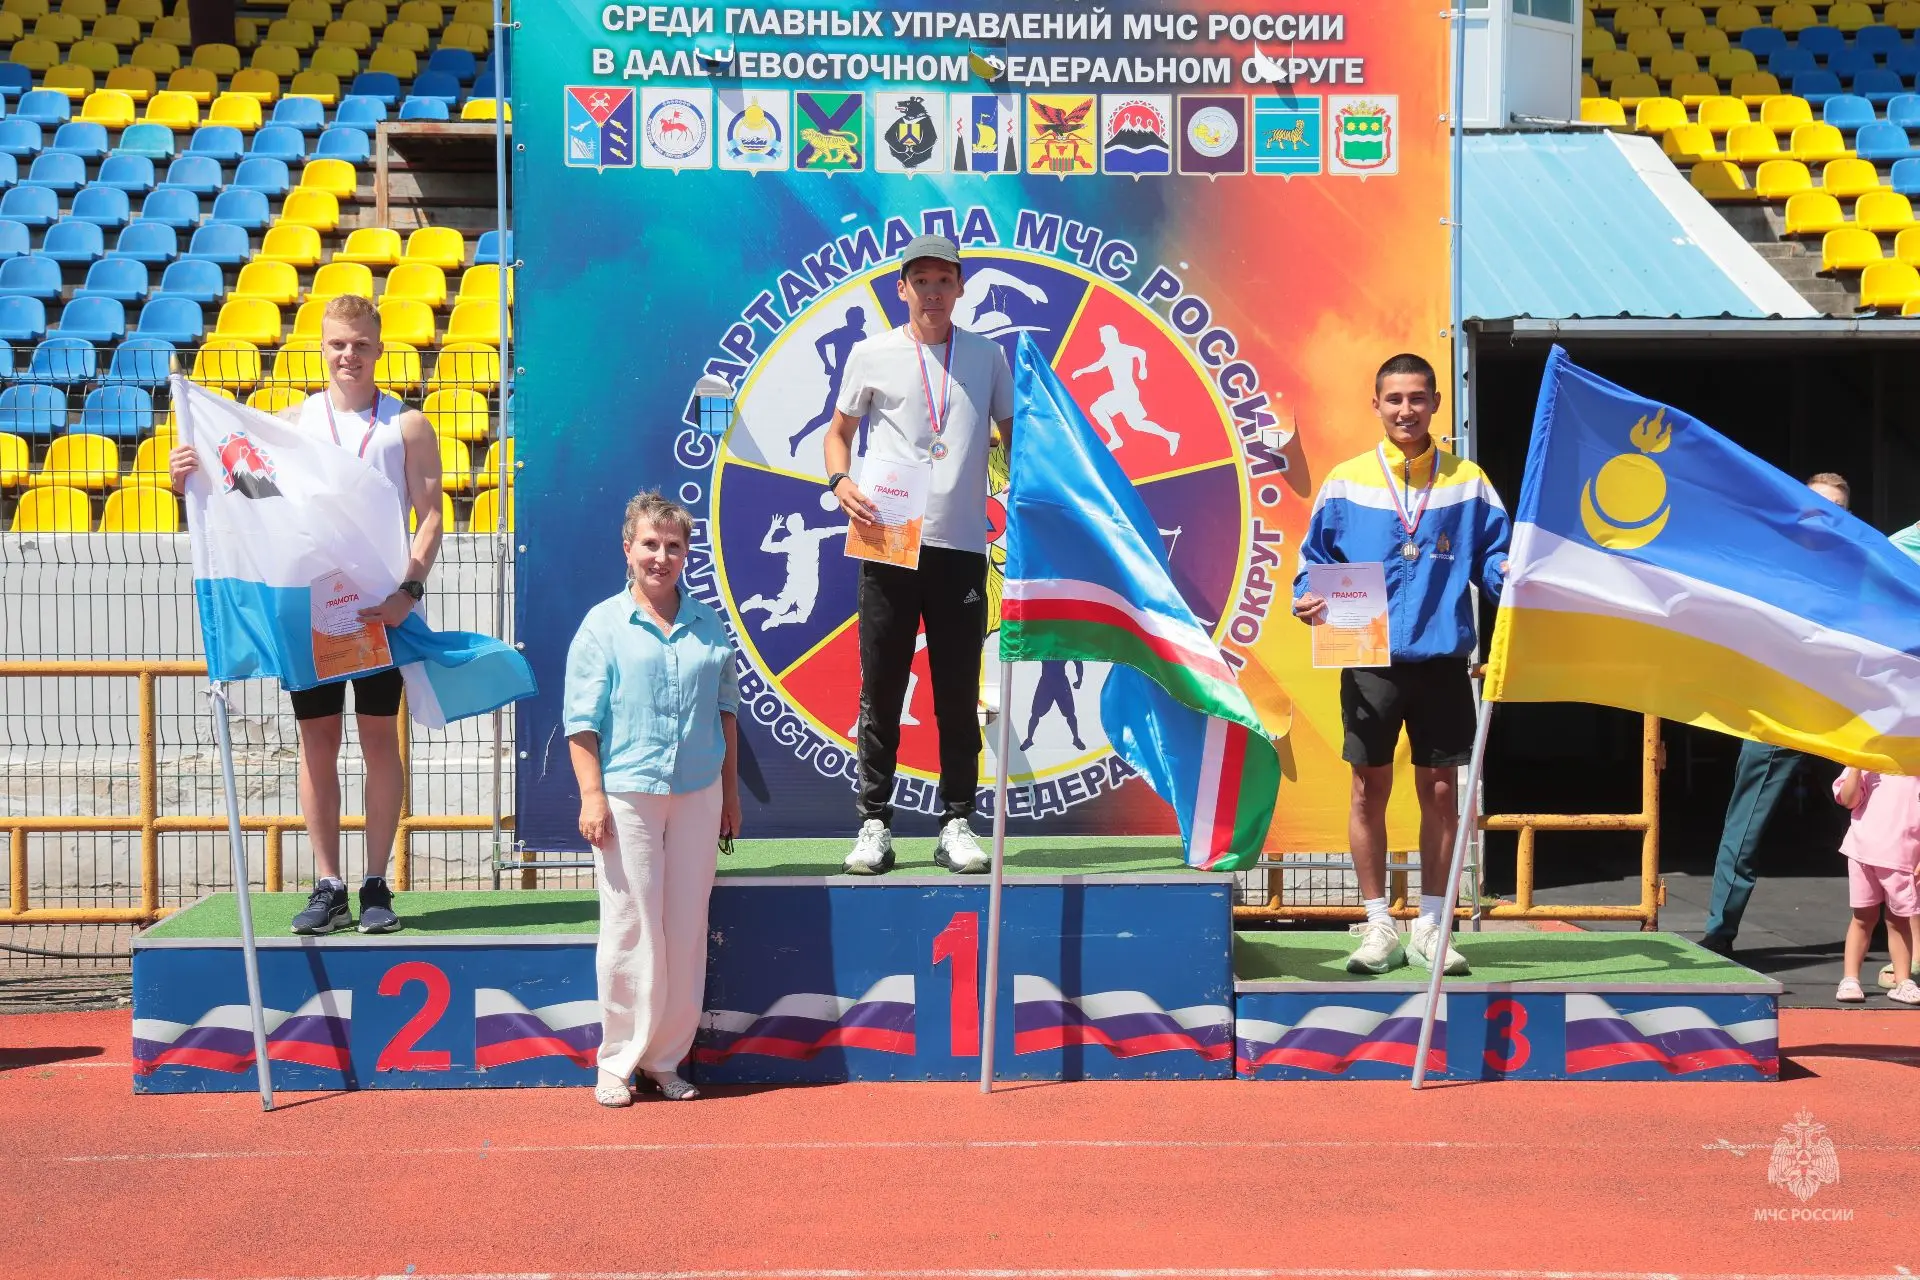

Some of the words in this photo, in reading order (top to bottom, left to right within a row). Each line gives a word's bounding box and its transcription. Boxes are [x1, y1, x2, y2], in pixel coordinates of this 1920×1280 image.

[601, 5, 714, 37] СРЕДИ
[725, 8, 883, 37] ГЛАВНЫХ
[892, 7, 1112, 40] УПРАВЛЕНИЙ
[1123, 13, 1198, 40] МЧС
[1208, 14, 1344, 41] РОССИИ
[592, 48, 615, 74] В
[675, 207, 998, 468] САРТАКИАДА
[1016, 209, 1136, 280] МЧС
[1139, 265, 1288, 478] РОССИИ
[873, 484, 909, 498] ГРАМОТА
[326, 594, 359, 608] ГРАМОТА
[1228, 518, 1283, 646] ОКРУГ
[1331, 591, 1368, 599] ГРАМОТА
[932, 911, 980, 1057] 1
[376, 960, 452, 1073] 2
[1482, 998, 1532, 1073] 3
